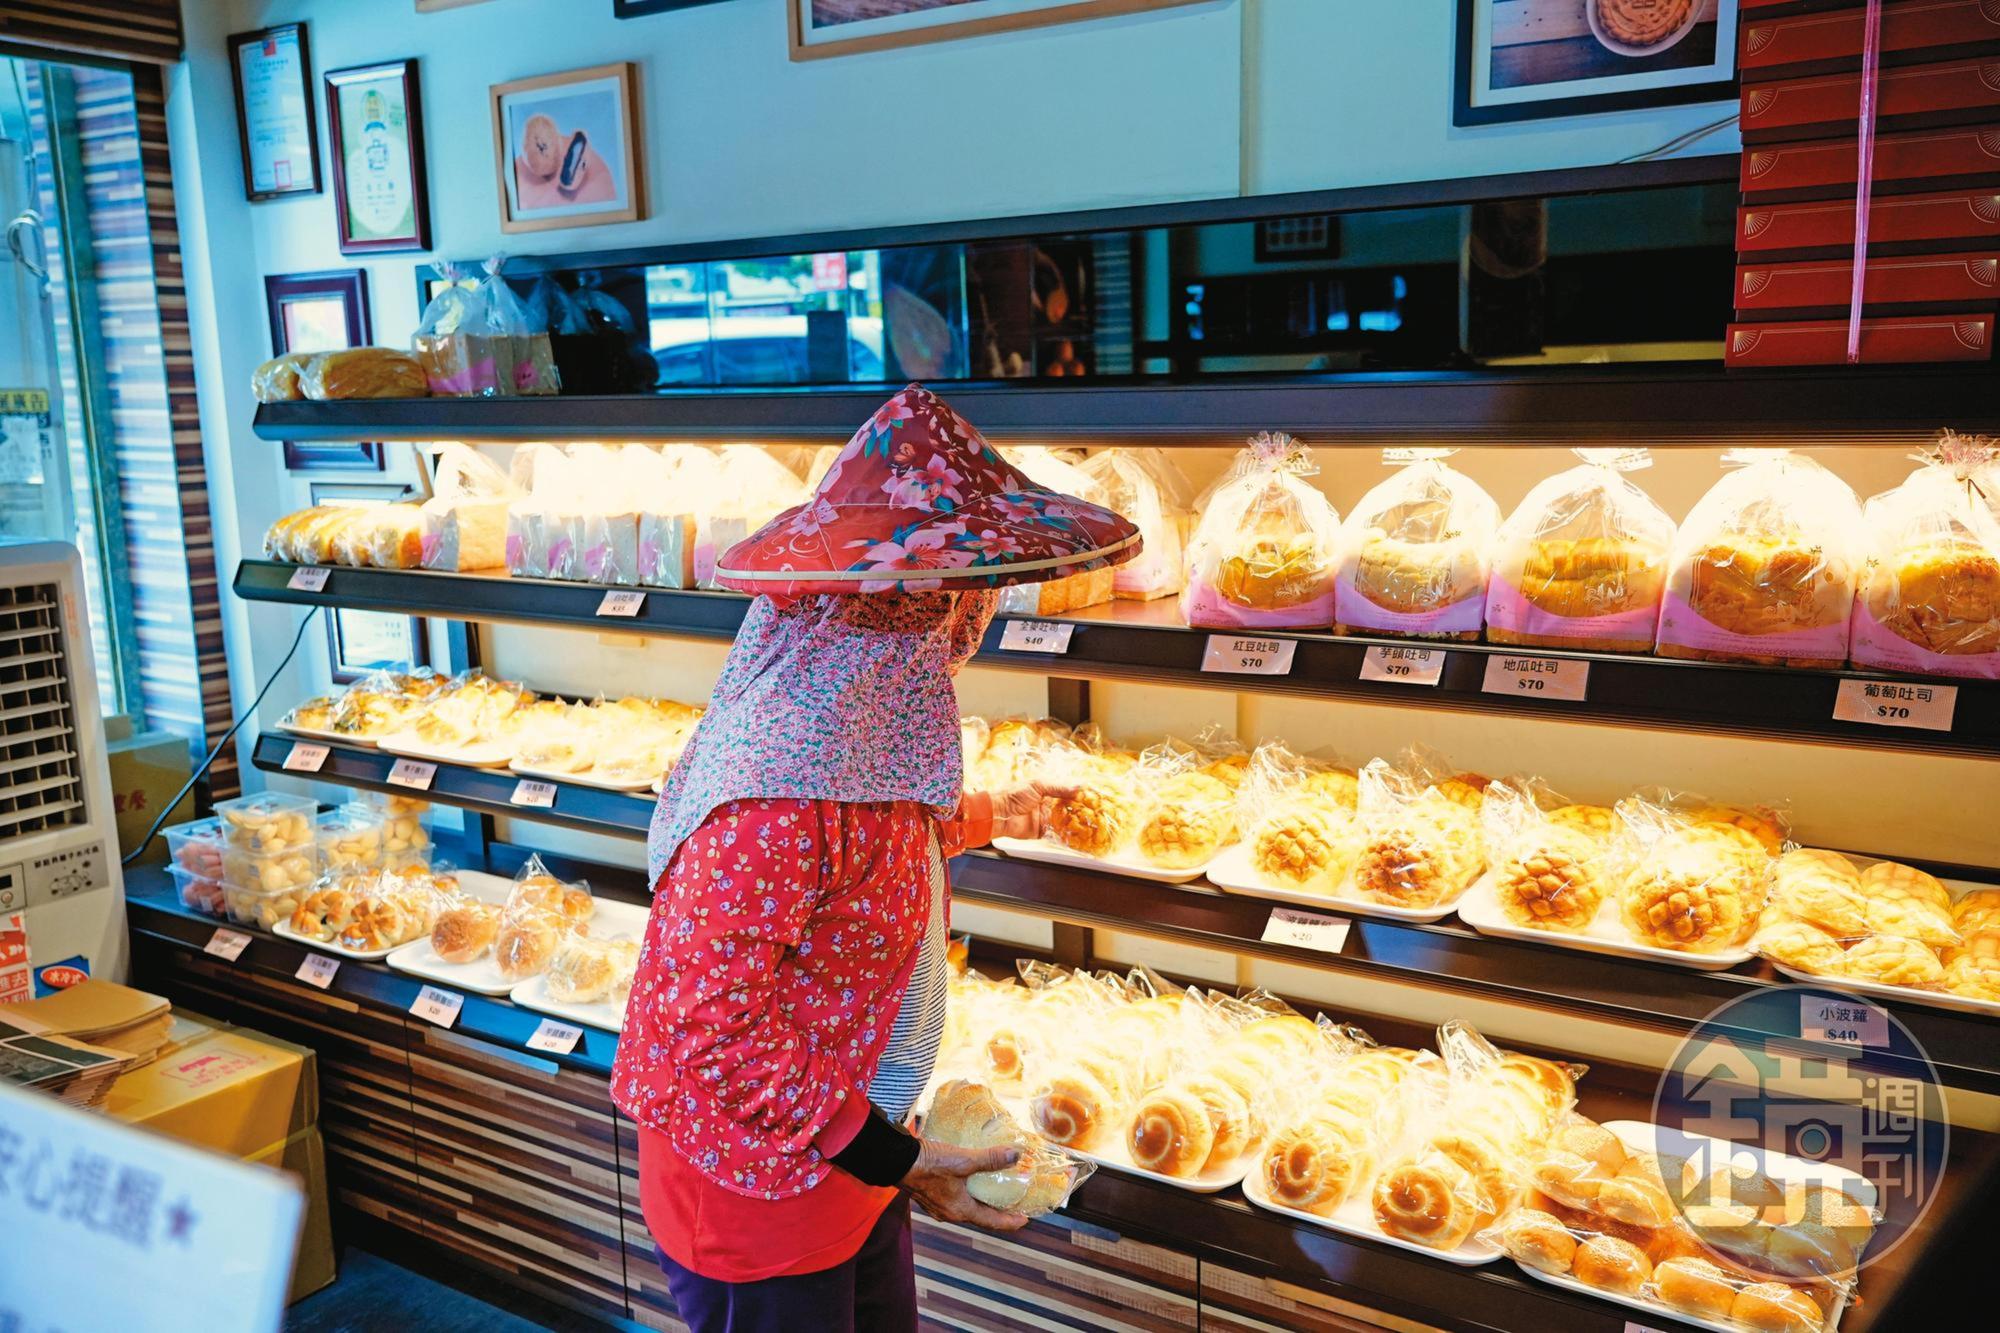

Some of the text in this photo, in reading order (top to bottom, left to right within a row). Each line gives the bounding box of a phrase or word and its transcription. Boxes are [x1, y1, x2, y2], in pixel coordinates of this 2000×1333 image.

[1024, 636, 1043, 645] $40
[1233, 640, 1280, 653] 紅豆吐司
[1379, 647, 1431, 662] 芋頭吐司
[1240, 657, 1263, 668] $70
[1503, 658, 1558, 674] 地瓜吐司
[1386, 665, 1410, 676] $70
[1518, 679, 1544, 690] $70
[1864, 683, 1933, 703] 葡萄吐司
[1877, 705, 1910, 719] $70
[1819, 1006, 1868, 1023] 小波蘿
[1827, 1029, 1858, 1041] $40
